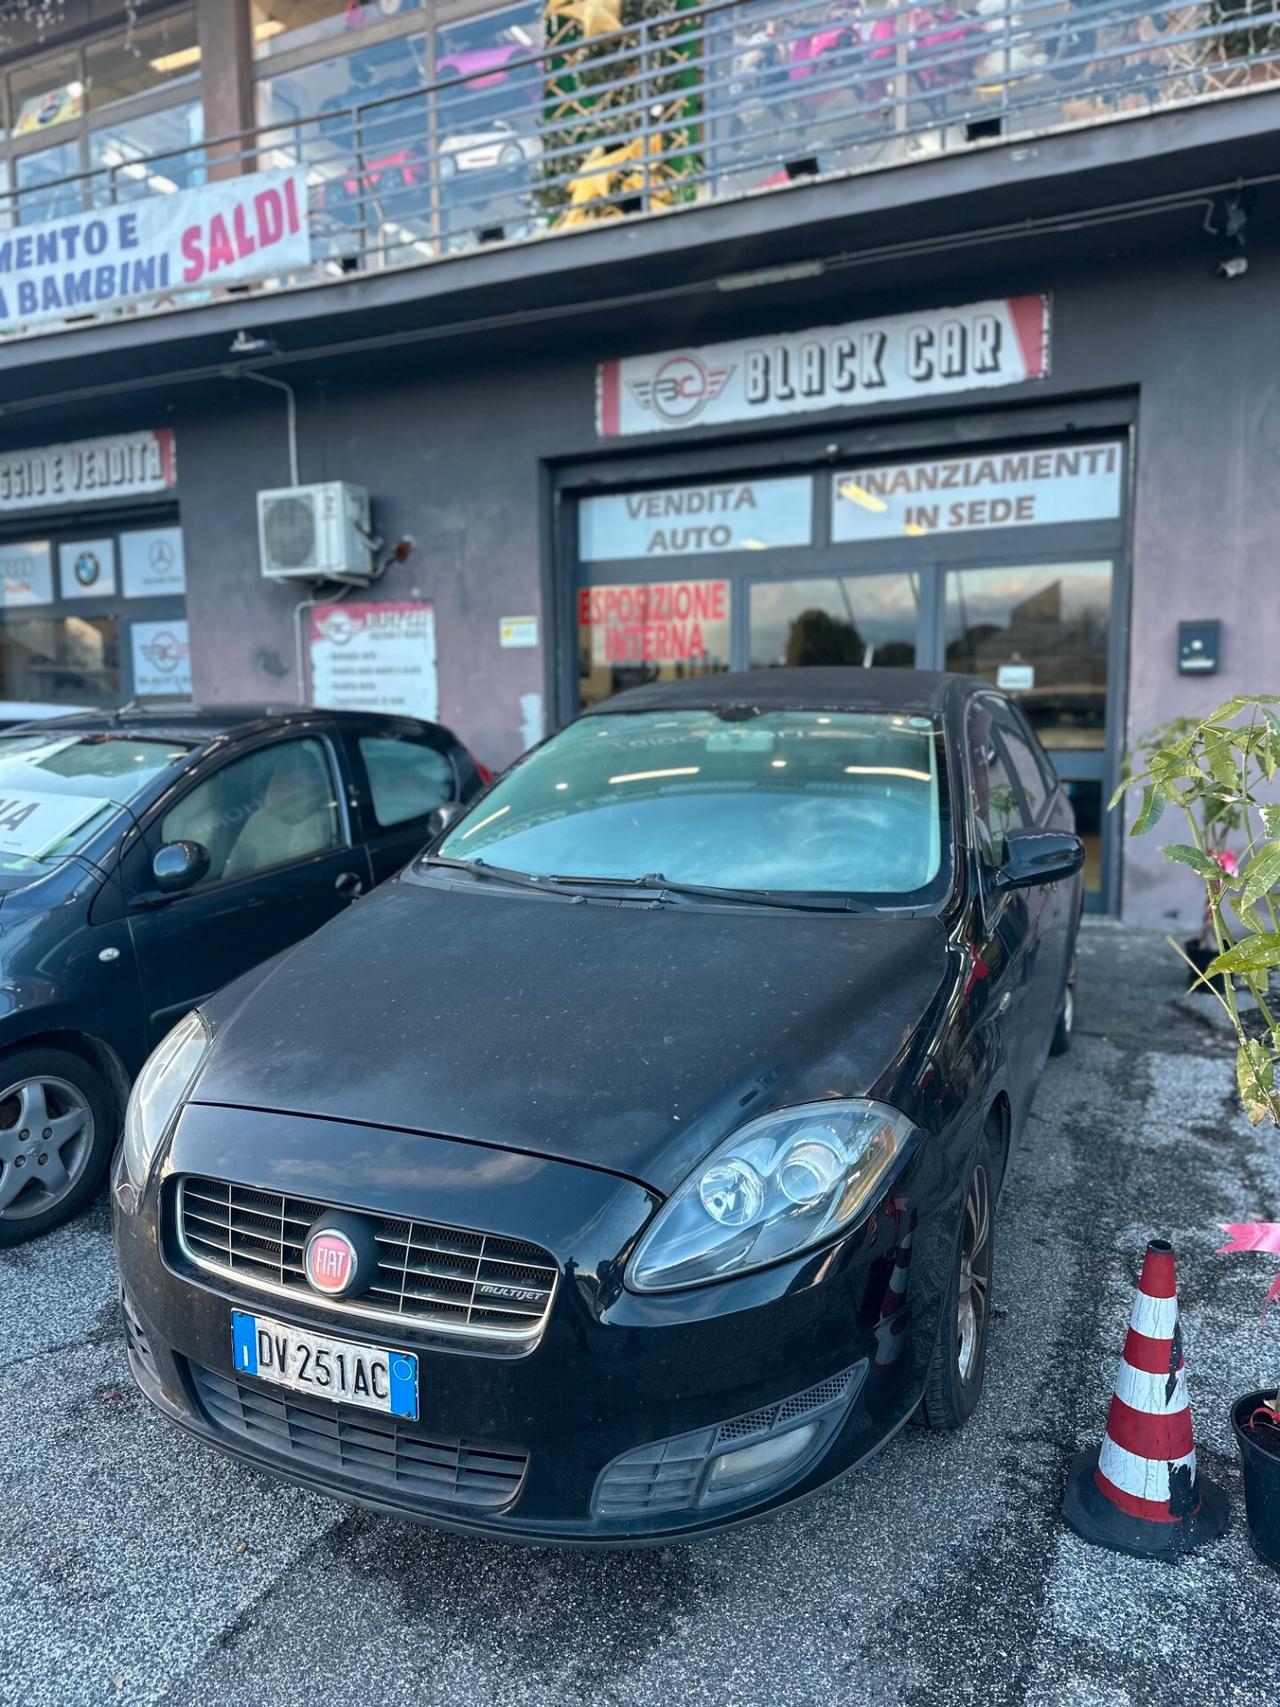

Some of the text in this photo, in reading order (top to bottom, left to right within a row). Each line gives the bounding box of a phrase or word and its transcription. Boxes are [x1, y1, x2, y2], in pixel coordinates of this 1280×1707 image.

[118, 213, 138, 250] E
[181, 177, 299, 284] SALDI
[18, 252, 170, 315] BAMBINI
[744, 313, 1001, 405] BLACK CAR
[70, 440, 163, 491] VENDITA
[837, 448, 1117, 500] FINANZIAMENTI
[625, 486, 758, 520] VENDITA
[903, 496, 1035, 530] IN SEDE
[646, 524, 733, 553] AUTO
[579, 581, 727, 625] ESPOSIZIONE
[604, 623, 705, 662] INTERNA
[316, 1246, 346, 1278] FIAT
[480, 1285, 545, 1301] MULTIJET
